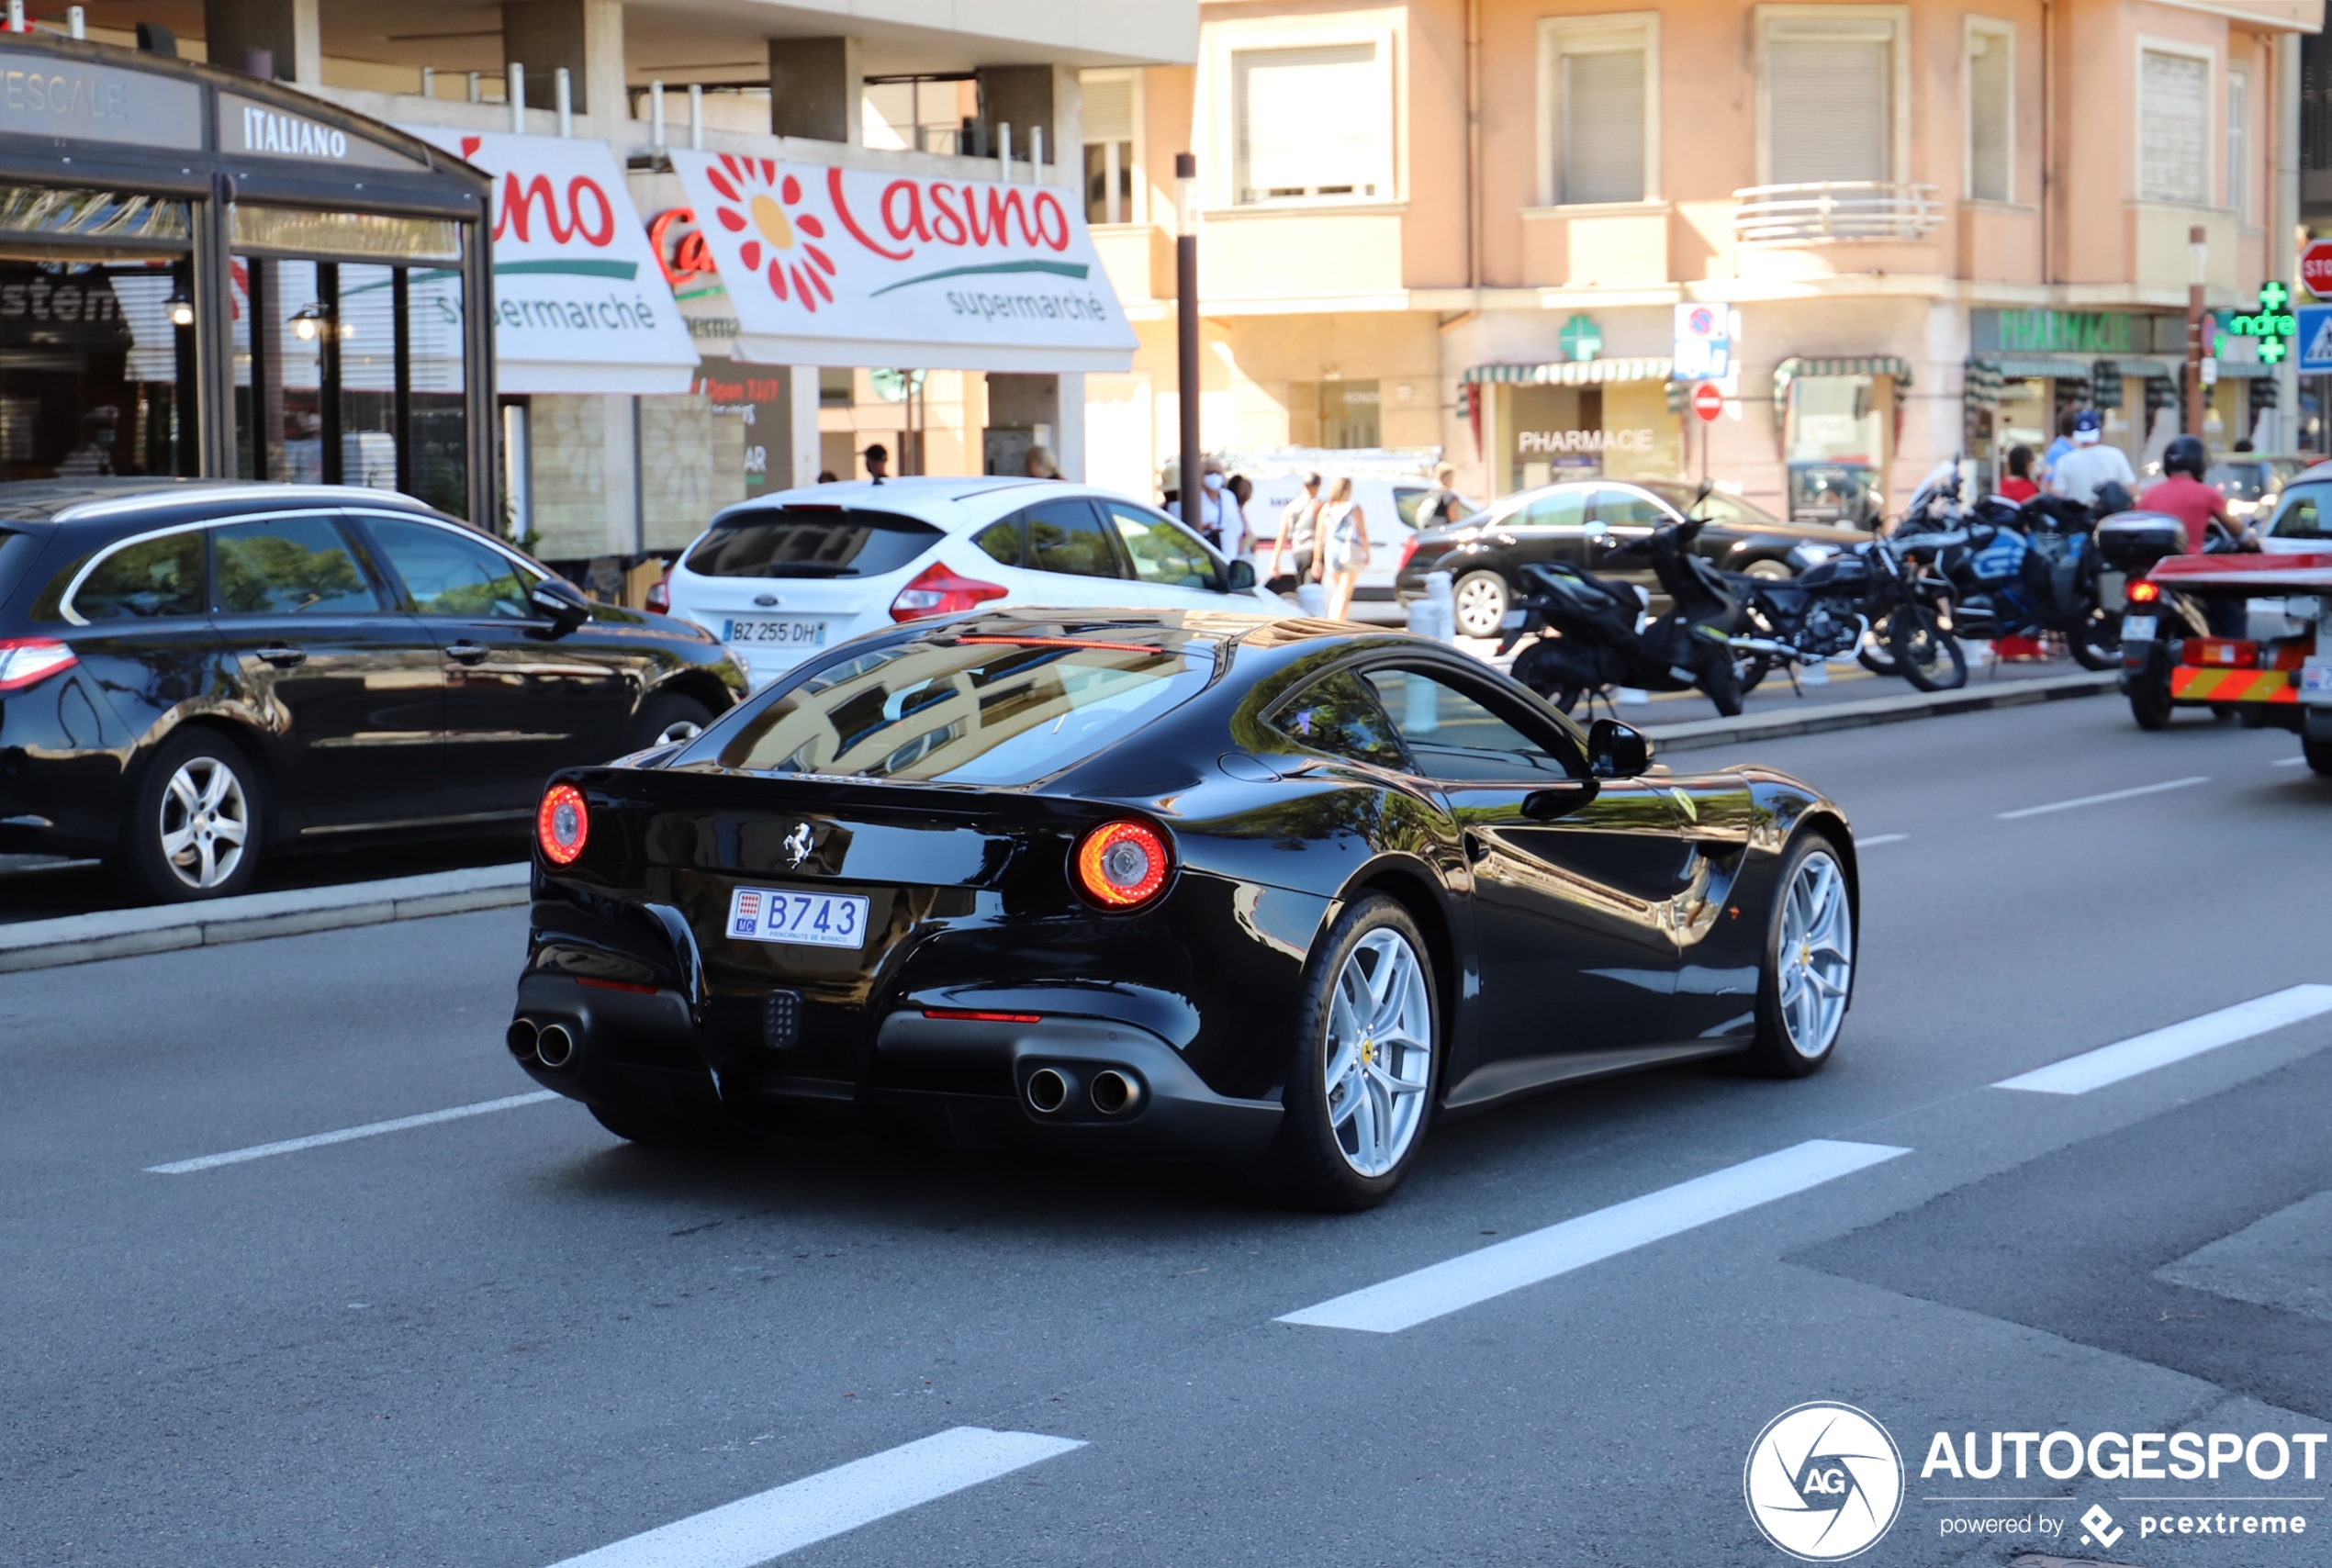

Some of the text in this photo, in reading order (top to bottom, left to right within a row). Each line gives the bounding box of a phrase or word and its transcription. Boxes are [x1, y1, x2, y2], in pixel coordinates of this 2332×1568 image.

[243, 106, 347, 159] ITALIANO
[826, 165, 1070, 261] Casino
[946, 289, 1107, 321] supermarché
[2000, 309, 2131, 352] PHARMACIE
[1518, 429, 1654, 454] PHARMACIE
[757, 622, 788, 642] 255
[792, 623, 815, 642] DH
[738, 919, 753, 932] MC
[768, 895, 857, 935] B743
[769, 931, 808, 940] PRINCIPAUTE
[821, 935, 847, 944] MONACO
